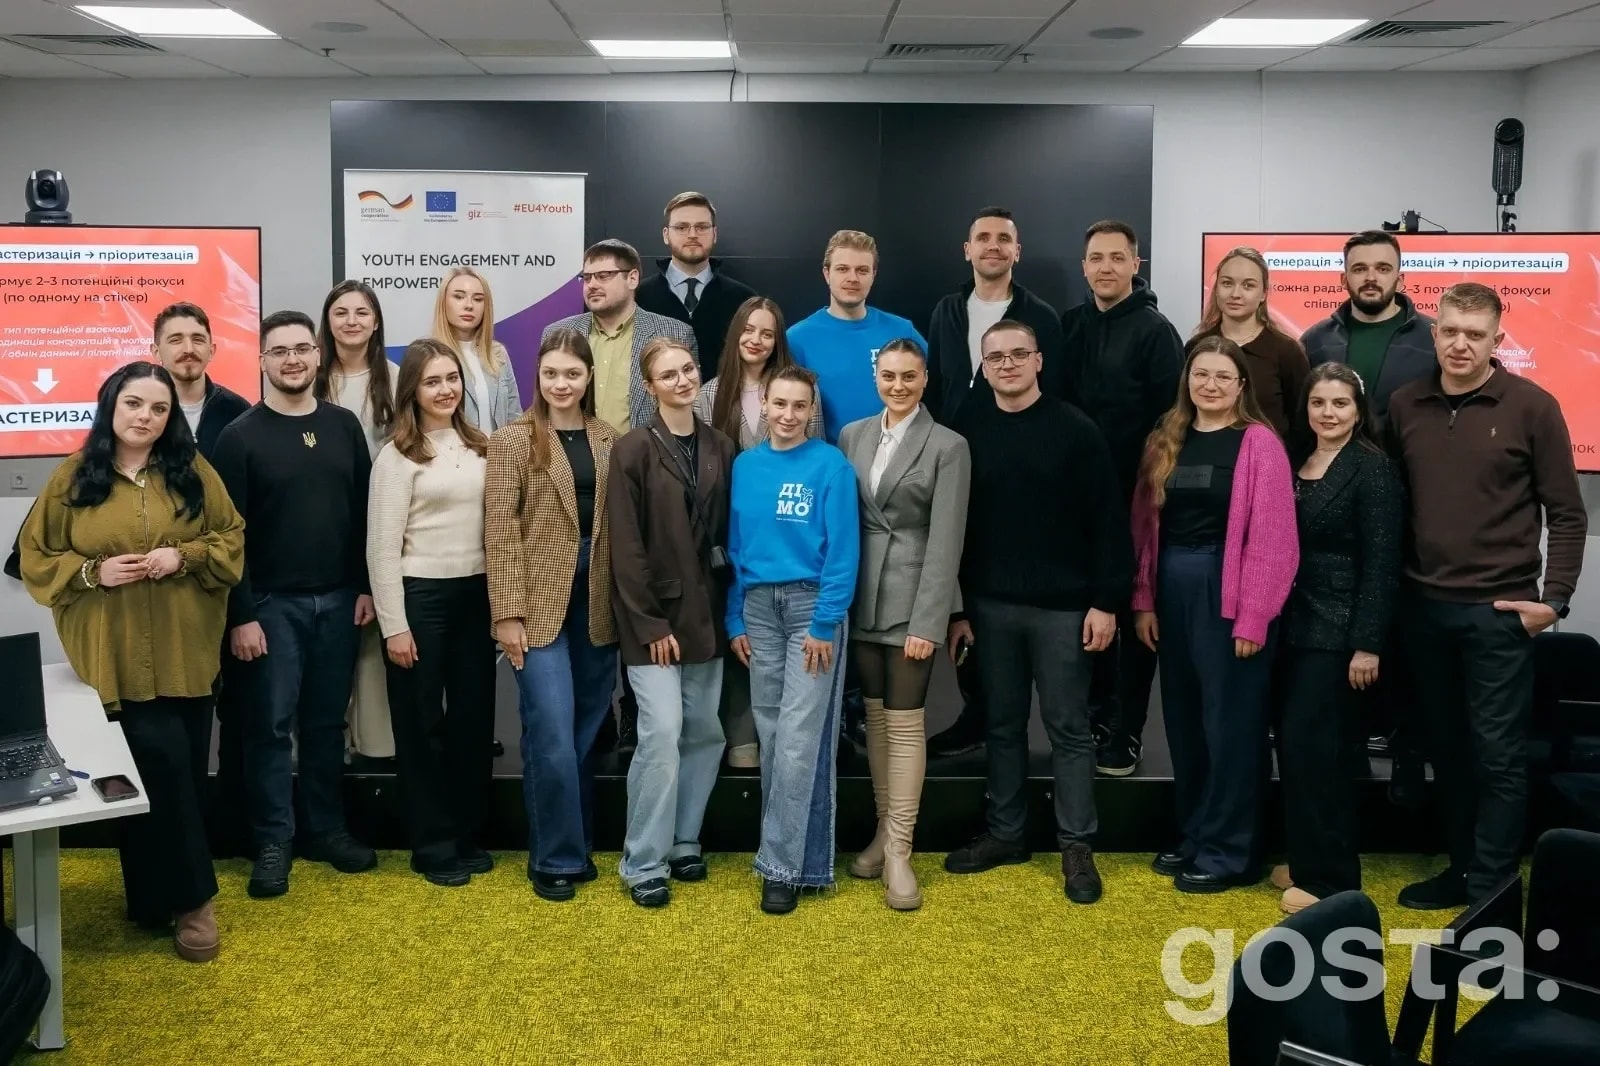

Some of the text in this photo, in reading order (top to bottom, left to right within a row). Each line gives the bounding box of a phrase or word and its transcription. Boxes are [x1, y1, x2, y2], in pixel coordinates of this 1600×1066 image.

[514, 204, 573, 213] #EU4Youth
[468, 209, 481, 220] giz
[99, 250, 194, 261] пріоритезація
[362, 254, 556, 267] YOUTH ENGAGEMENT AND
[1267, 257, 1331, 268] генерація
[1462, 257, 1563, 269] пріоритезація
[61, 276, 133, 287] потенційні
[137, 276, 184, 287] фокуси
[362, 277, 442, 289] EMPOWER
[1500, 285, 1551, 297] фокуси
[4, 292, 148, 304] (по одному на стікер)
[24, 325, 84, 334] потенційної
[47, 336, 112, 347] консультацій
[8, 350, 38, 358] обмін
[39, 351, 80, 359] даними
